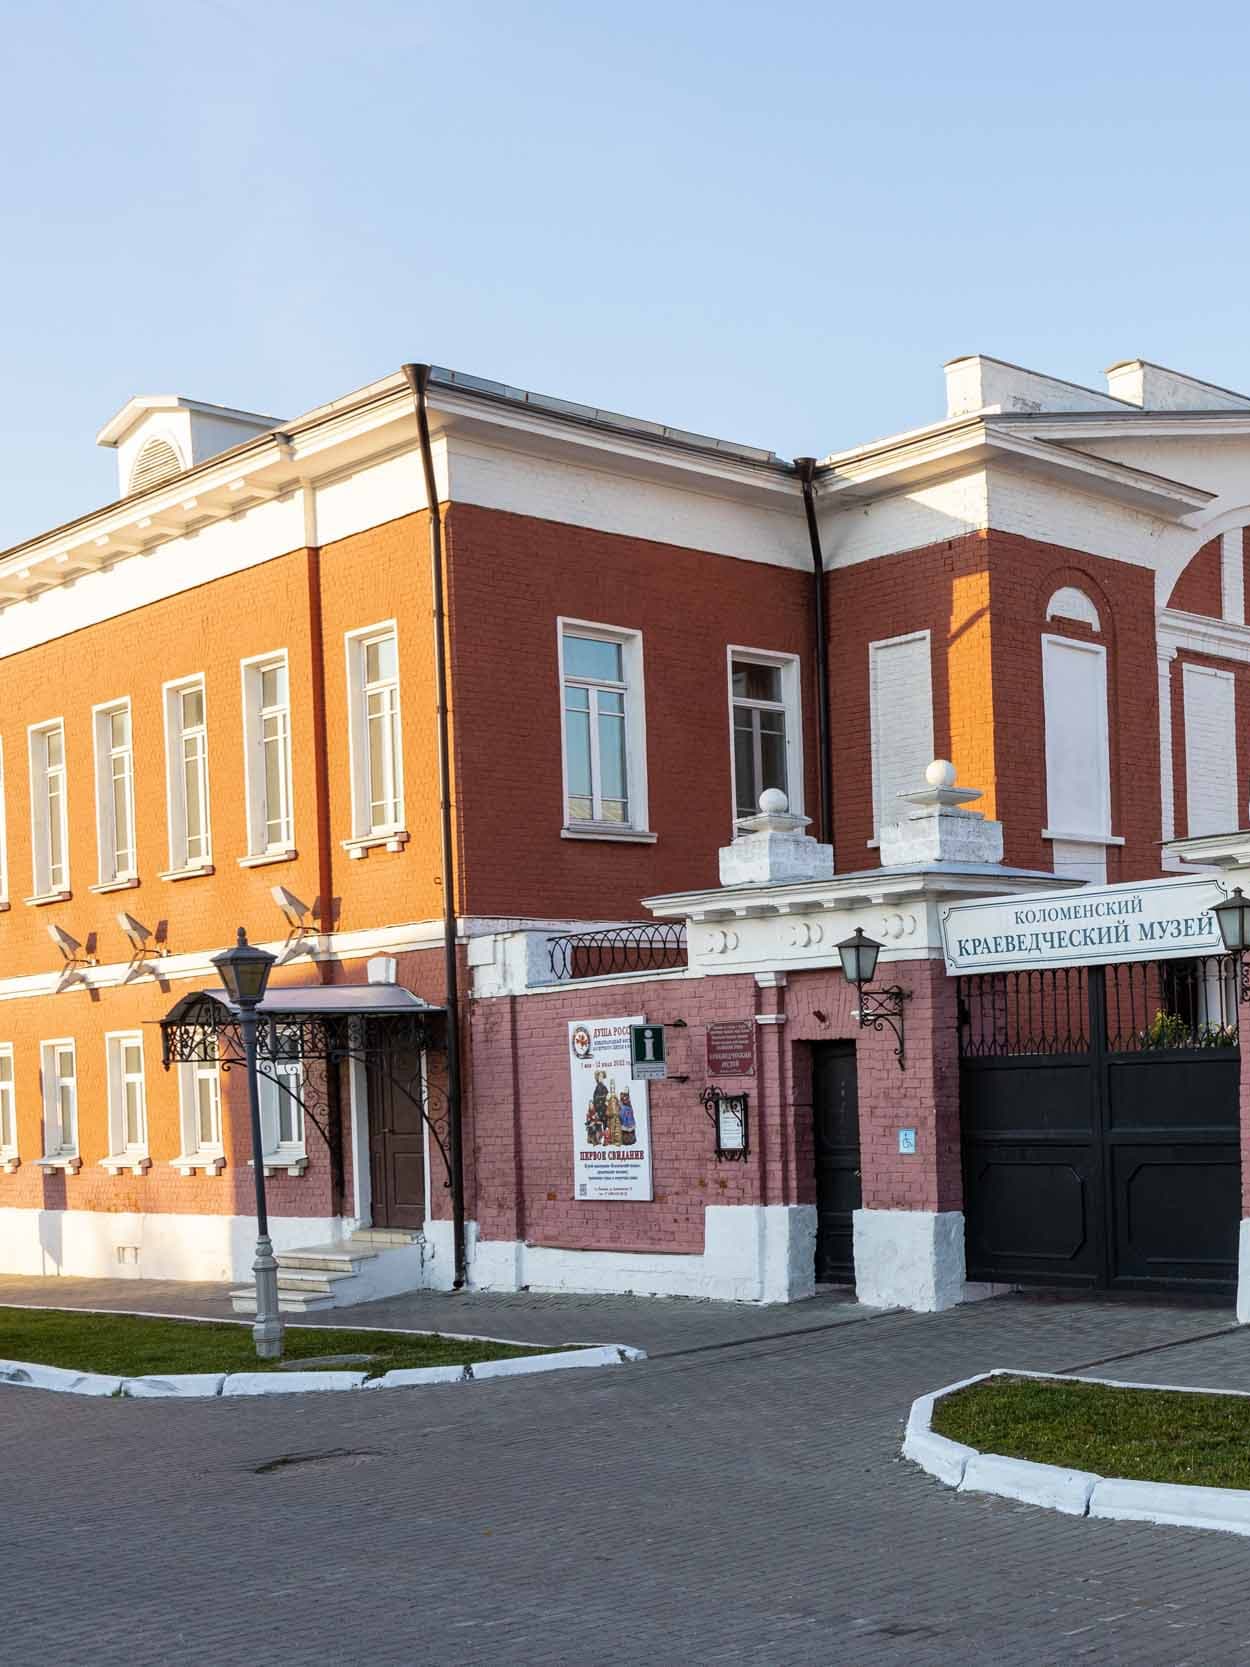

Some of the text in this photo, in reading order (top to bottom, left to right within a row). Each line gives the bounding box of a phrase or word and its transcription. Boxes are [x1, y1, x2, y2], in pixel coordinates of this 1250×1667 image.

[1014, 895, 1143, 925] КОЛОМЕНСКИЙ
[957, 912, 1214, 958] КРАЕВЕДЧЕСКИЙ МУЗЕЙ
[593, 1027, 612, 1038] ДУША
[580, 1150, 644, 1162] ПЕРВОЕ СВИДАНИЕ
